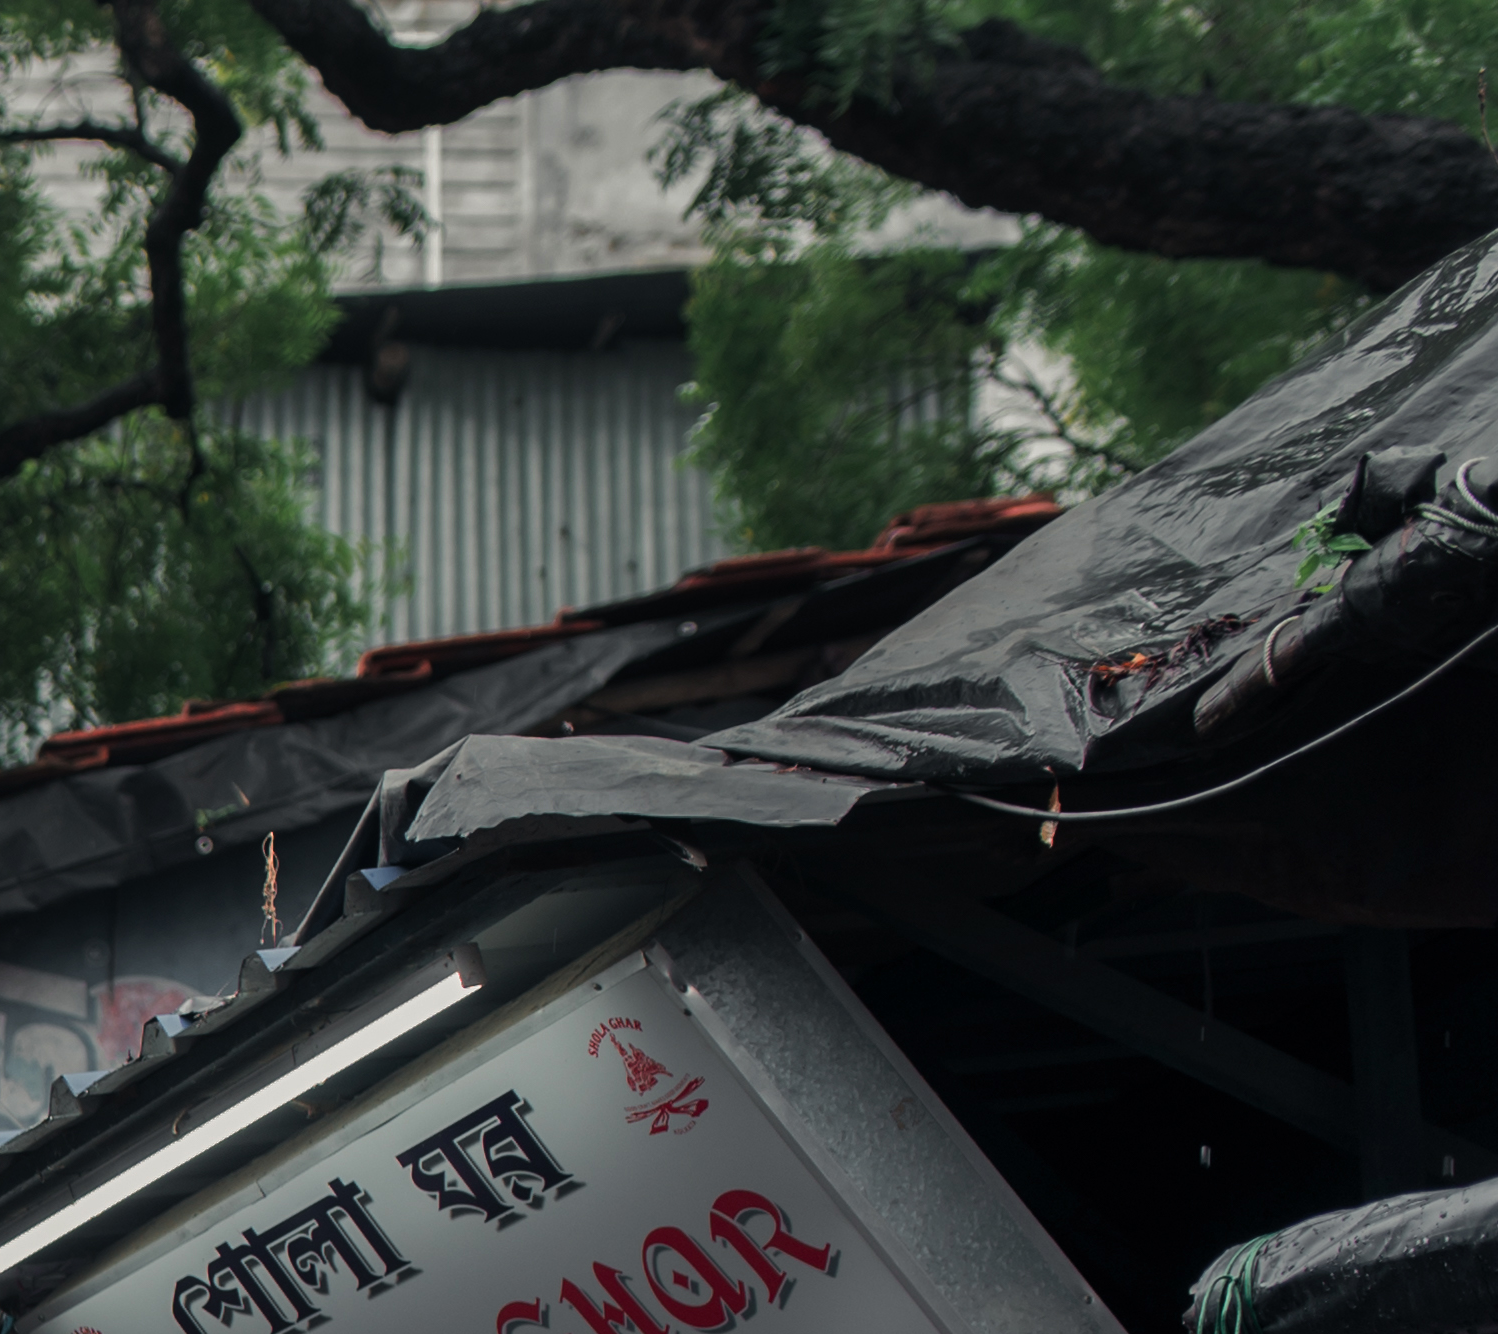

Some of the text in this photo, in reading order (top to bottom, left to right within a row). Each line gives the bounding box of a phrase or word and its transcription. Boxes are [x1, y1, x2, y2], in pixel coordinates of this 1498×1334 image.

[588, 1017, 644, 1058] SHOLA GHAR
[395, 1089, 579, 1227] ঘর
